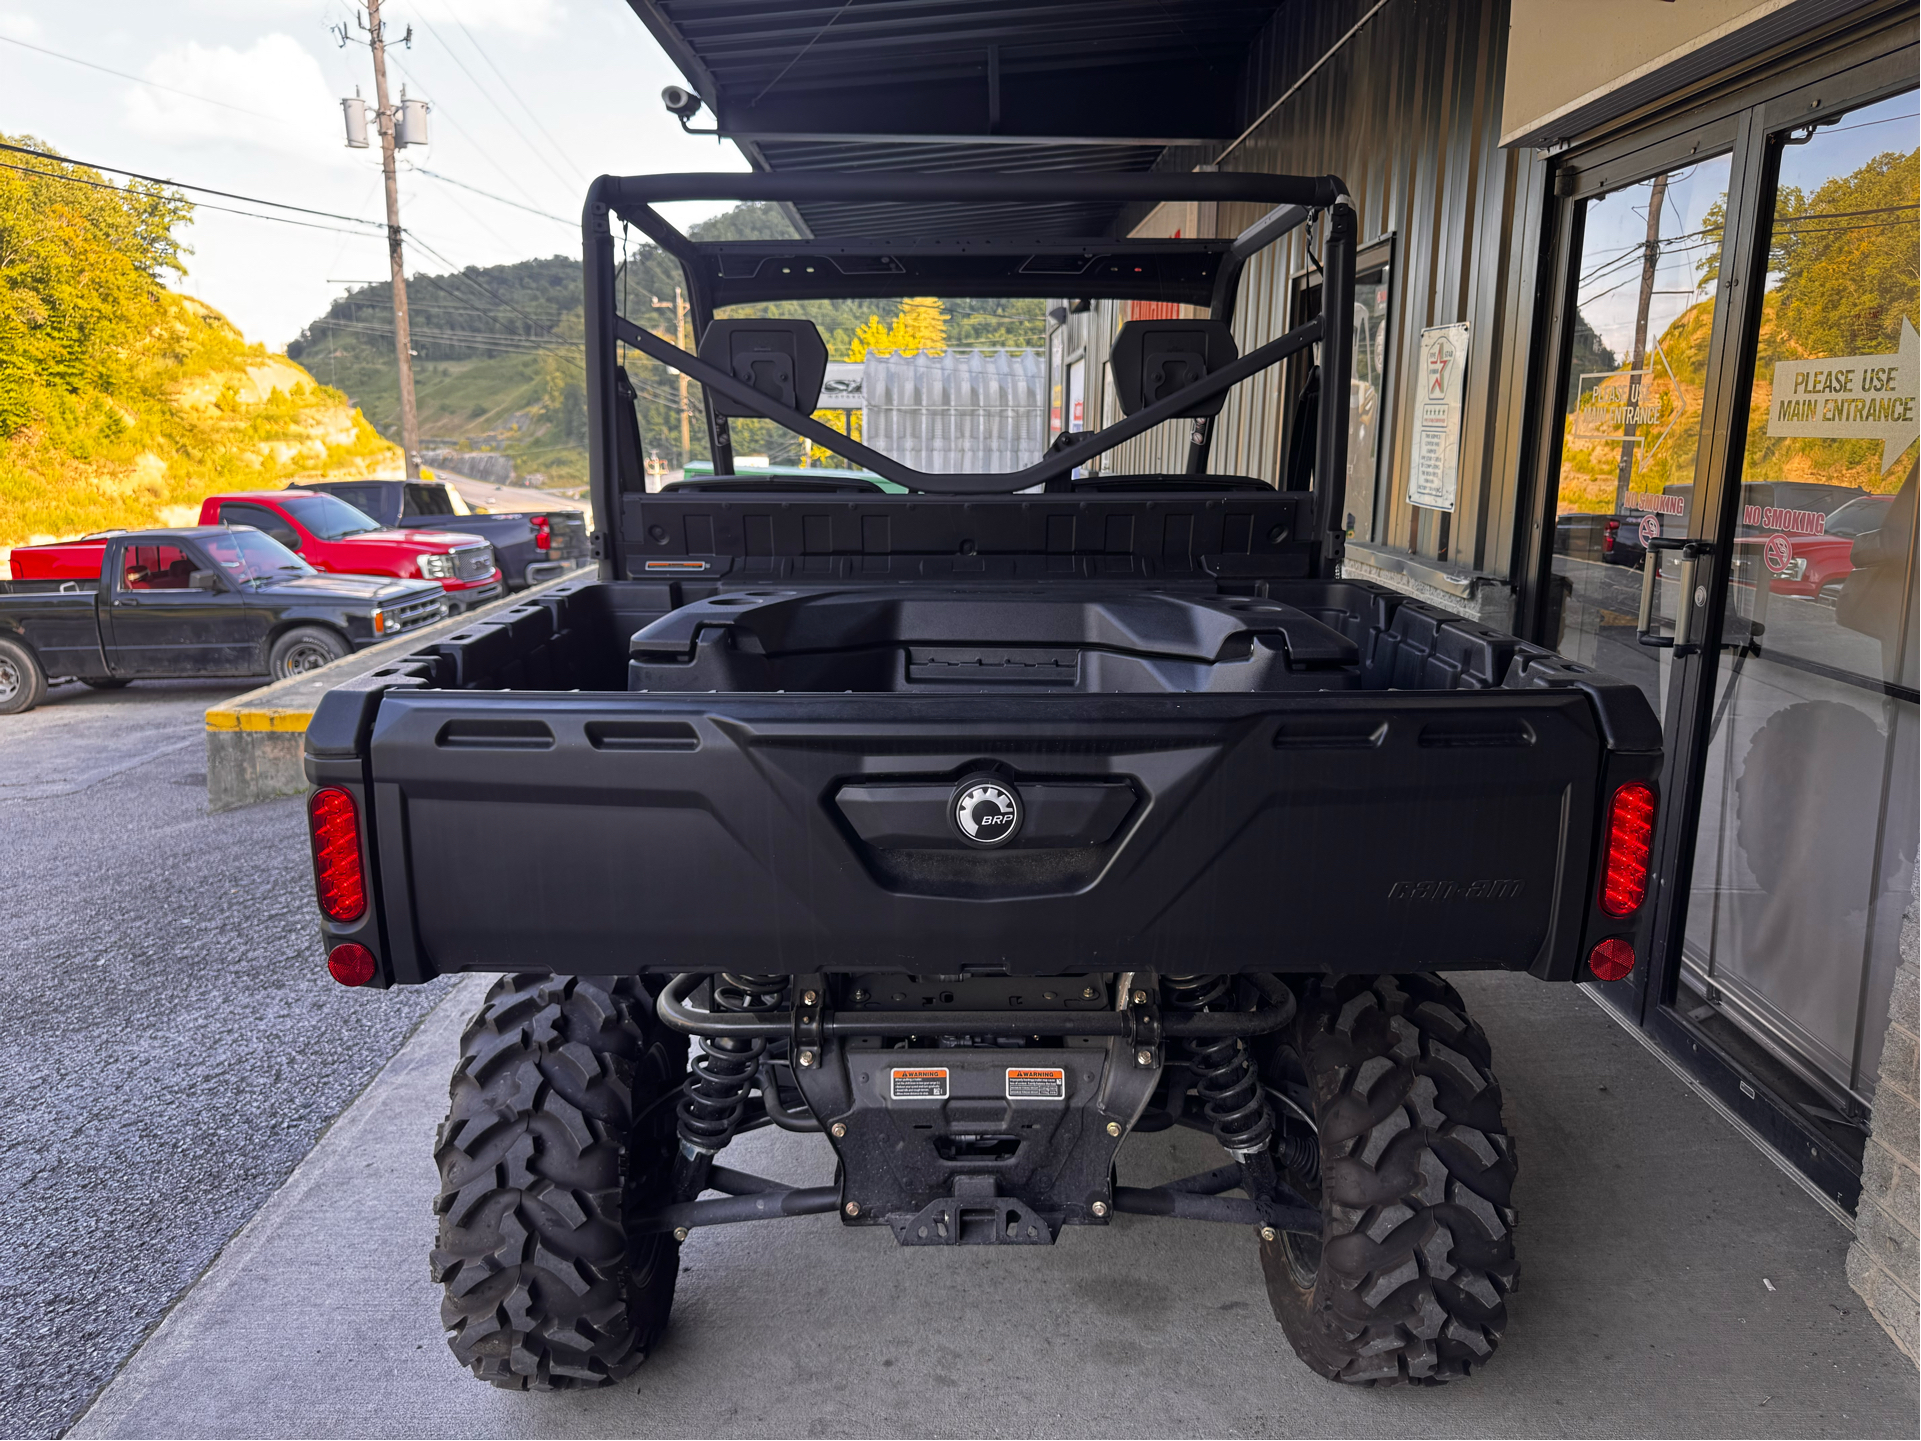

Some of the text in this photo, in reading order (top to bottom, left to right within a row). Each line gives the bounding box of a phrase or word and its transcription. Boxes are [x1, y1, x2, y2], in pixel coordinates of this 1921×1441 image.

[1793, 367, 1899, 394] PLEASE USE
[1592, 384, 1653, 402] PLEASE USE
[1583, 406, 1661, 425] MAIN ENTRANCE
[1777, 397, 1916, 422] MAIN ENTRANCE
[1624, 491, 1684, 516] NO SMOKING
[1743, 505, 1825, 535] NO SMOKING
[981, 814, 1013, 825] BRP
[1388, 879, 1526, 900] can-am
